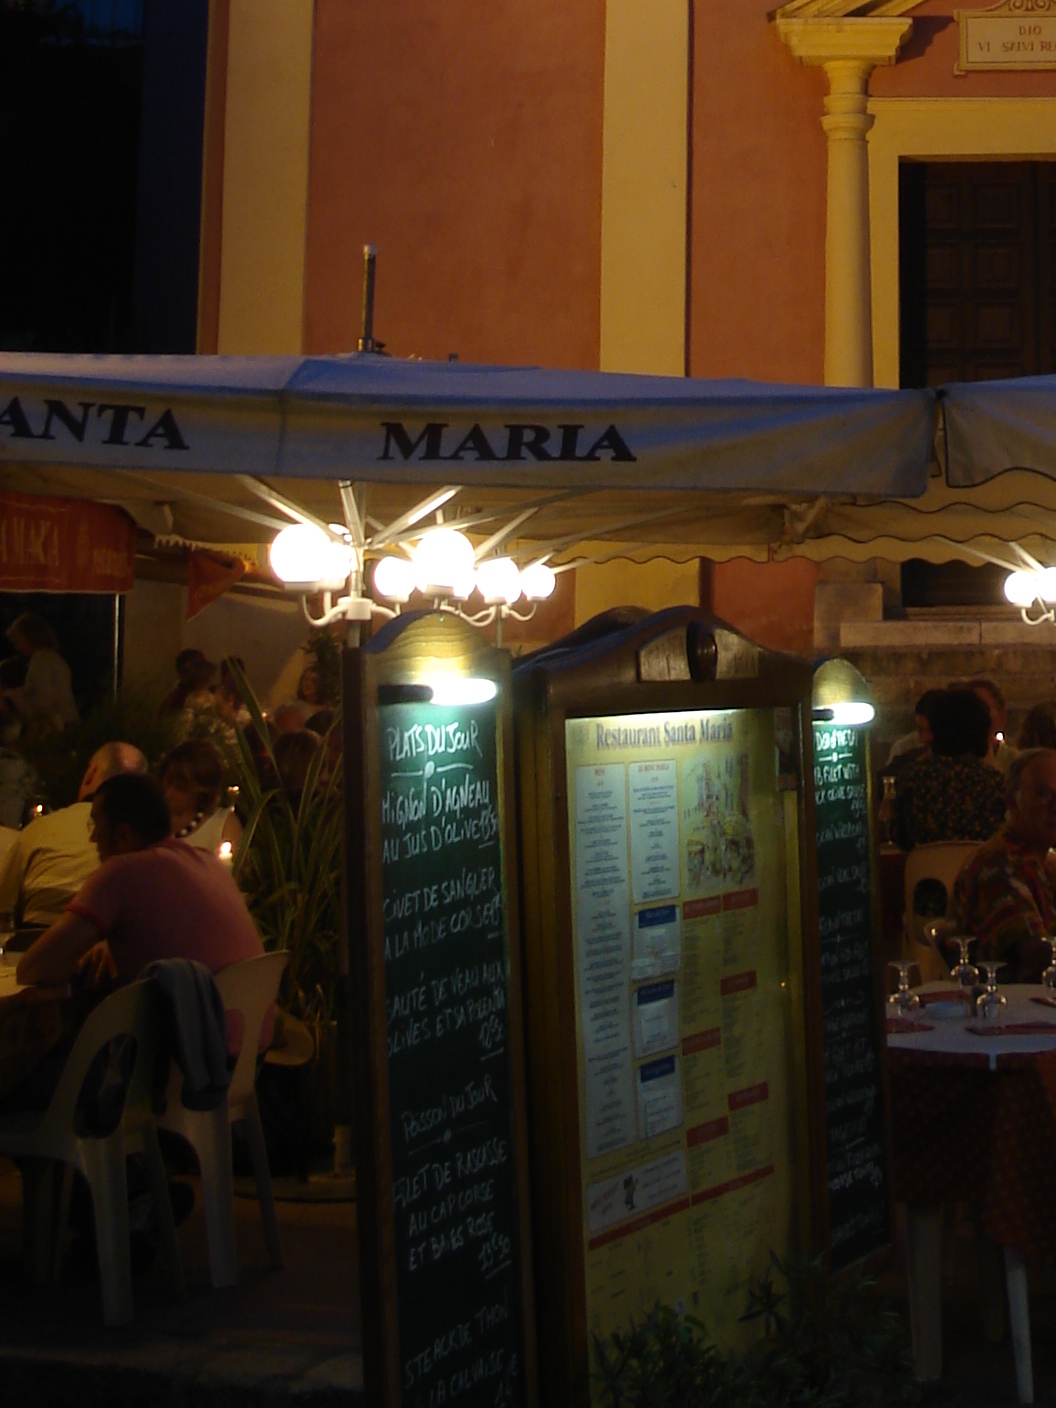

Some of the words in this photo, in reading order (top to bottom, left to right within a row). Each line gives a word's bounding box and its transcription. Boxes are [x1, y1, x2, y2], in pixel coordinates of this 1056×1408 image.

[1018, 25, 1042, 36] DIO
[376, 422, 638, 462] MARIA
[596, 723, 661, 748] Restaurant
[663, 721, 696, 745] Santa
[699, 717, 734, 743] Maria
[382, 839, 400, 864] AU
[403, 831, 428, 859] JUS
[423, 884, 439, 912] DE
[395, 930, 410, 959] LA
[430, 977, 448, 1008] DE
[431, 1161, 452, 1191] DE
[409, 1211, 428, 1237] AU
[430, 1193, 456, 1224] CAP
[409, 1241, 428, 1272] ET
